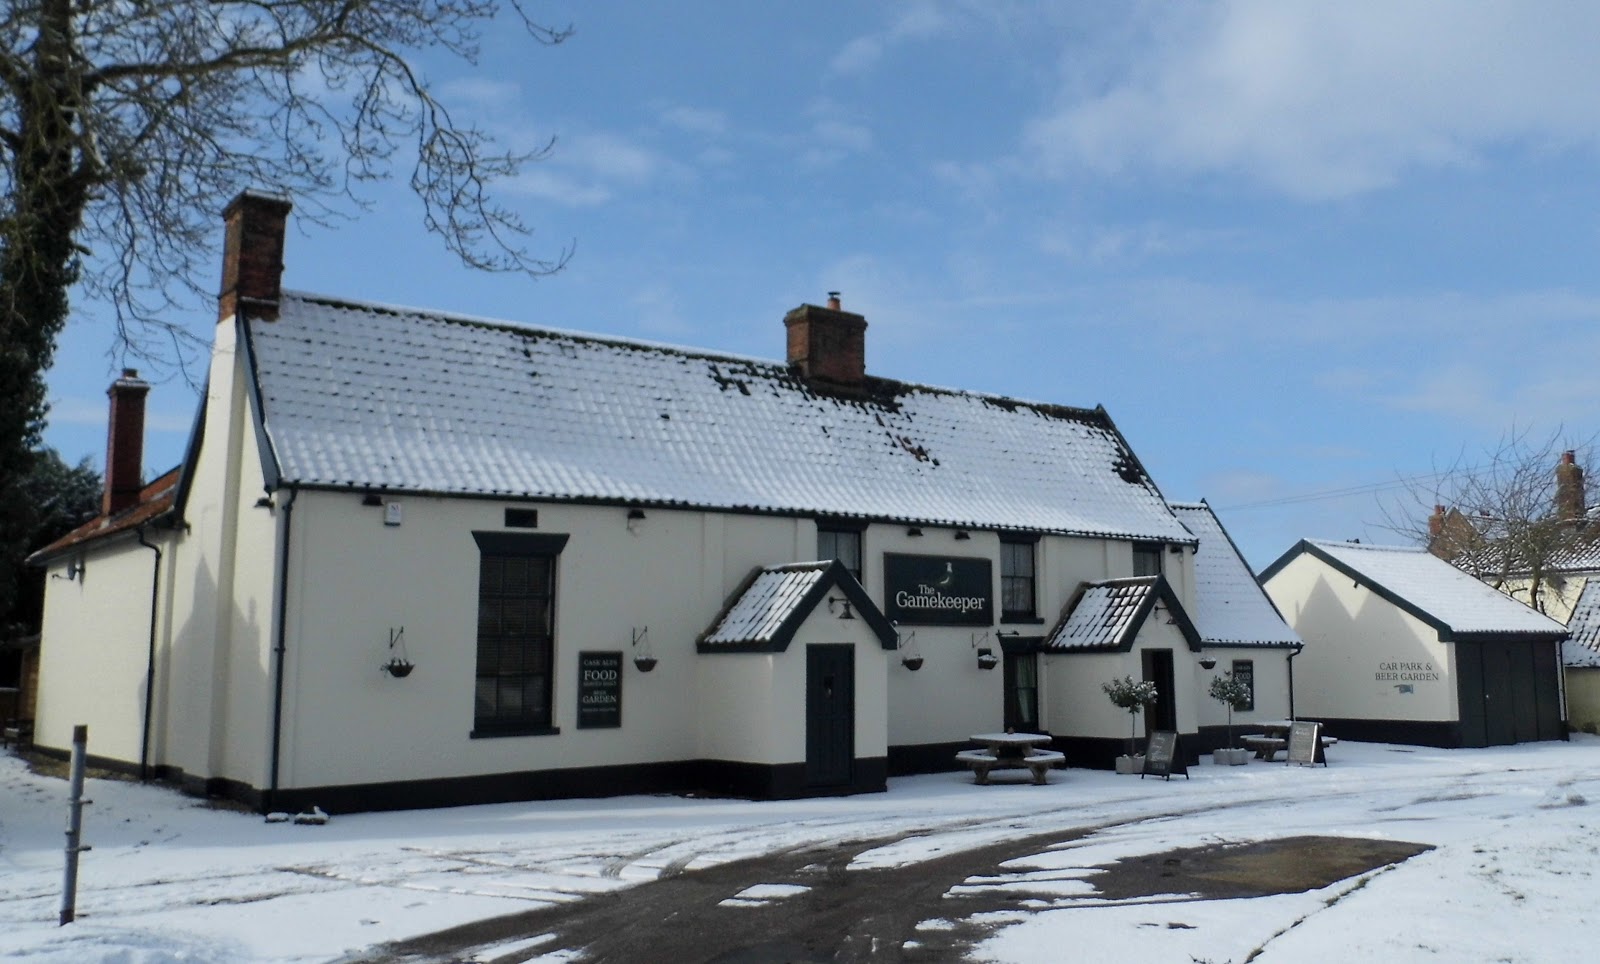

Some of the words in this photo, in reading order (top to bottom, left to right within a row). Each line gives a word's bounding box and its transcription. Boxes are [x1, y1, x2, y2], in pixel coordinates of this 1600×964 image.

[918, 584, 935, 595] The
[896, 590, 985, 613] Gamekeeper
[1379, 662, 1398, 671] CAR
[1400, 662, 1423, 671] PARK
[1425, 662, 1432, 671] &
[584, 669, 617, 680] FOOD
[1375, 672, 1399, 681] BEER
[1400, 672, 1439, 681] GARDEN
[582, 695, 617, 704] GARDEN
